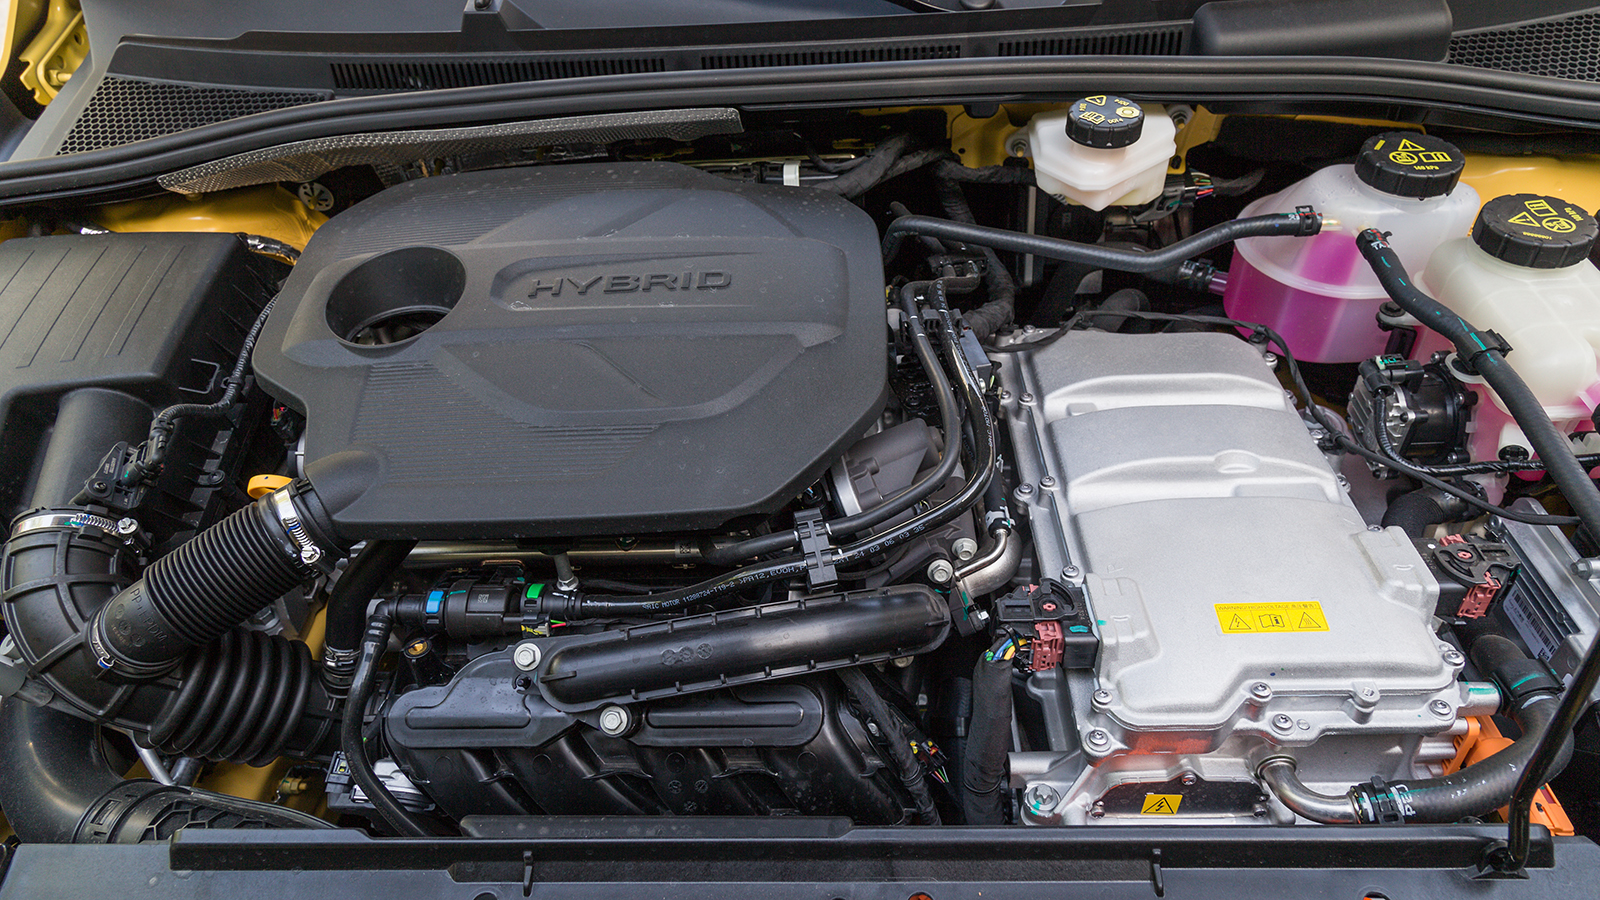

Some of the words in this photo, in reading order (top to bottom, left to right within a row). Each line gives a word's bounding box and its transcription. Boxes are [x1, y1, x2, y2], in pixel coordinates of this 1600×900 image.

[528, 270, 732, 298] HYBRID
[869, 544, 881, 554] 03
[661, 598, 680, 608] MOTOR
